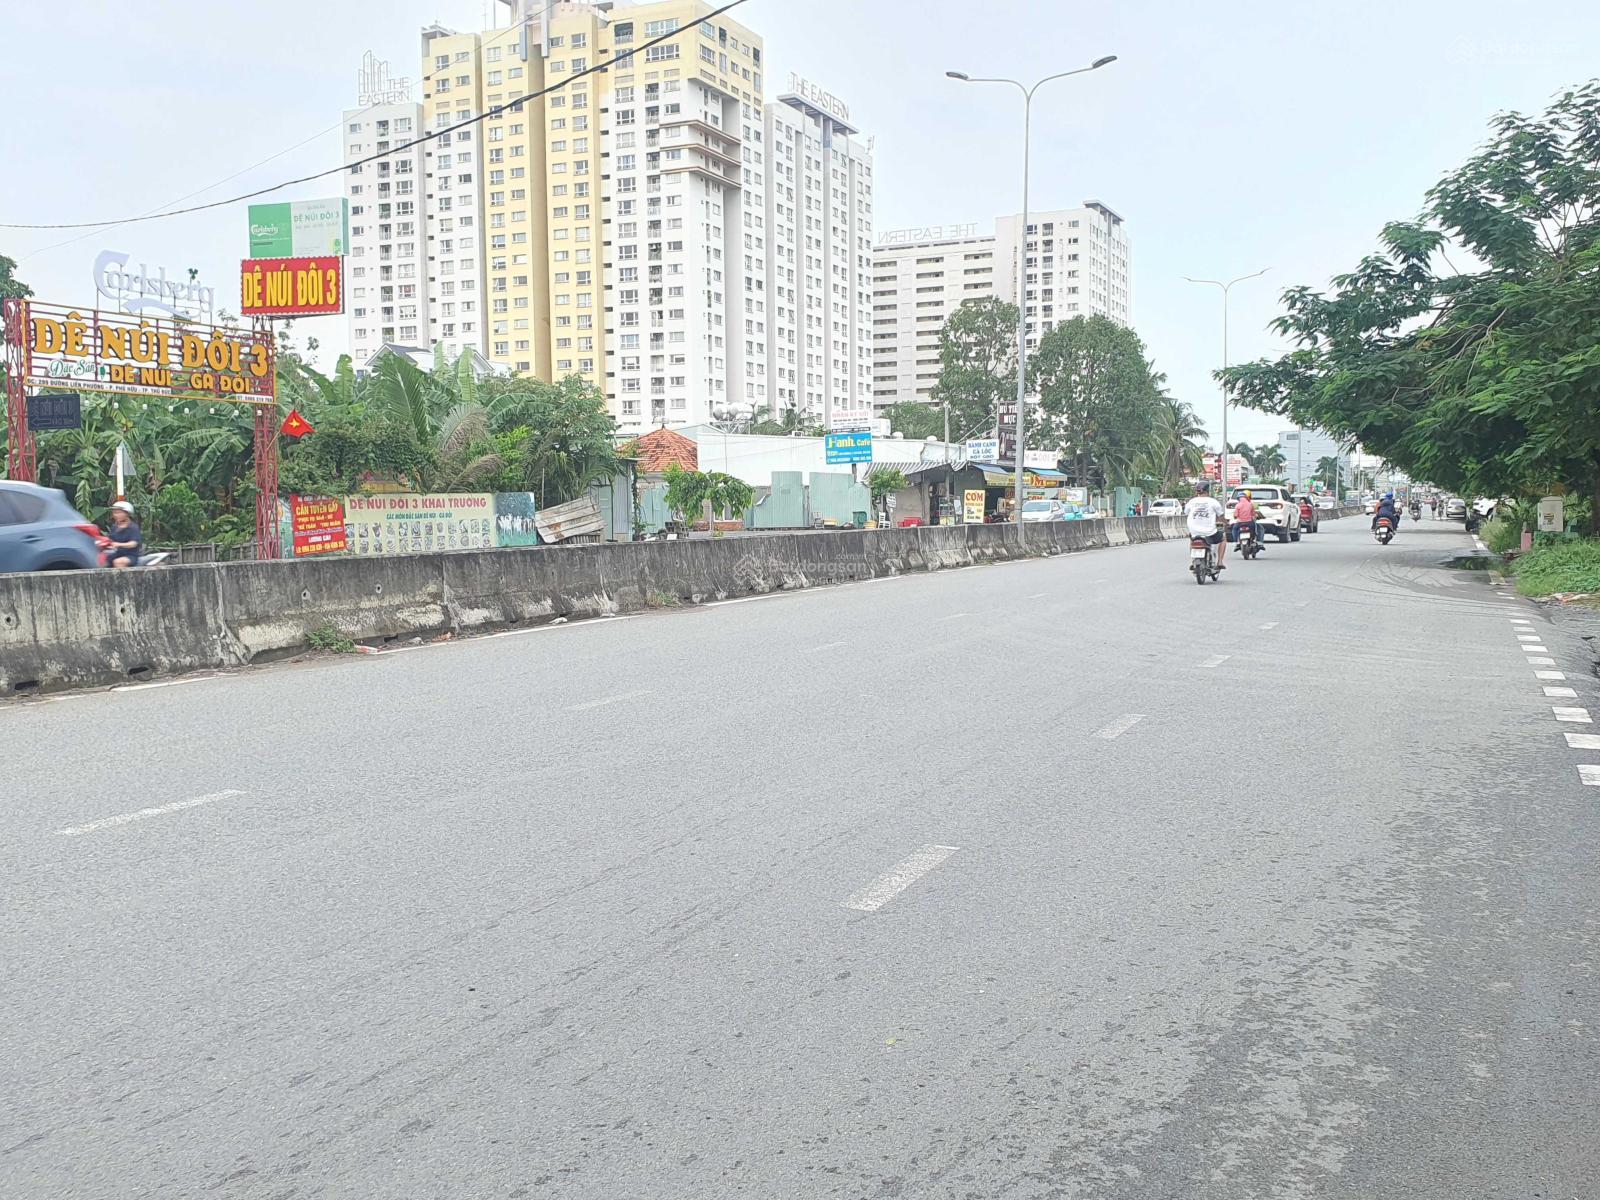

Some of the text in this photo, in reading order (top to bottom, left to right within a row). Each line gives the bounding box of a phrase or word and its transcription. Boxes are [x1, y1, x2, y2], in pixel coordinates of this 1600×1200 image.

[358, 90, 409, 106] EASTERN
[386, 77, 409, 91] THE
[790, 71, 849, 120] THE EASTERN
[250, 223, 279, 236] Carlsberg
[92, 249, 214, 317] Carlsberg
[243, 261, 337, 308] DÊ NÚI ĐÔI 3
[31, 310, 89, 358] DÊ
[181, 330, 242, 372] ĐÔI
[250, 343, 268, 377] 3
[412, 498, 418, 509] 3
[421, 498, 446, 509] KHAI
